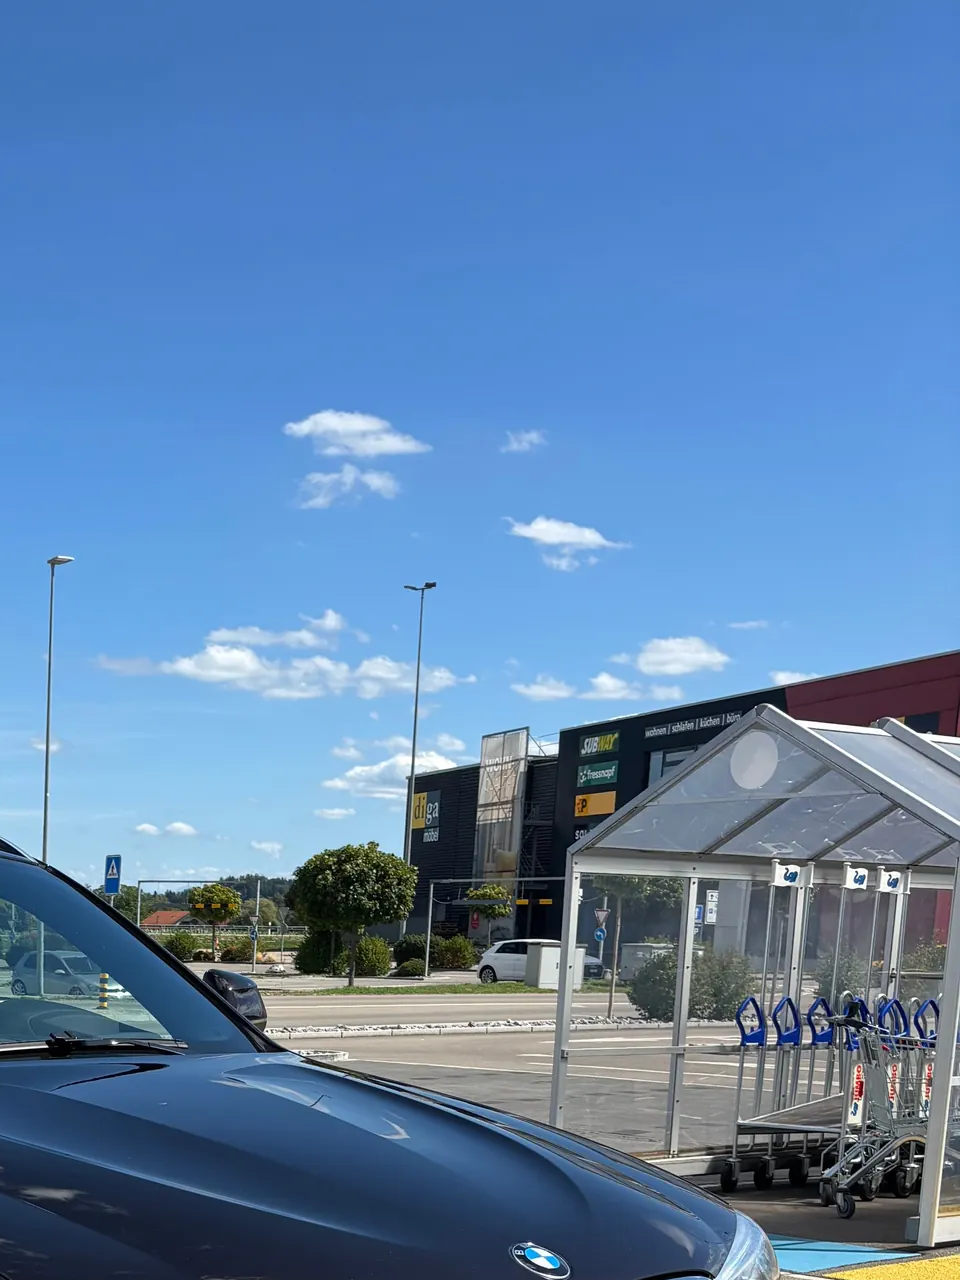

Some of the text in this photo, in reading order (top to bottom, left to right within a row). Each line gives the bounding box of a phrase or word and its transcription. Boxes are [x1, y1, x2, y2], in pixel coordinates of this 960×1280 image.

[645, 727, 667, 738] wohnen
[671, 720, 695, 733] schlafen
[699, 715, 721, 728] küchen
[581, 732, 619, 755] SUBWAY
[587, 765, 616, 780] fressnapf
[414, 796, 439, 825] diga
[423, 827, 440, 843] möbel
